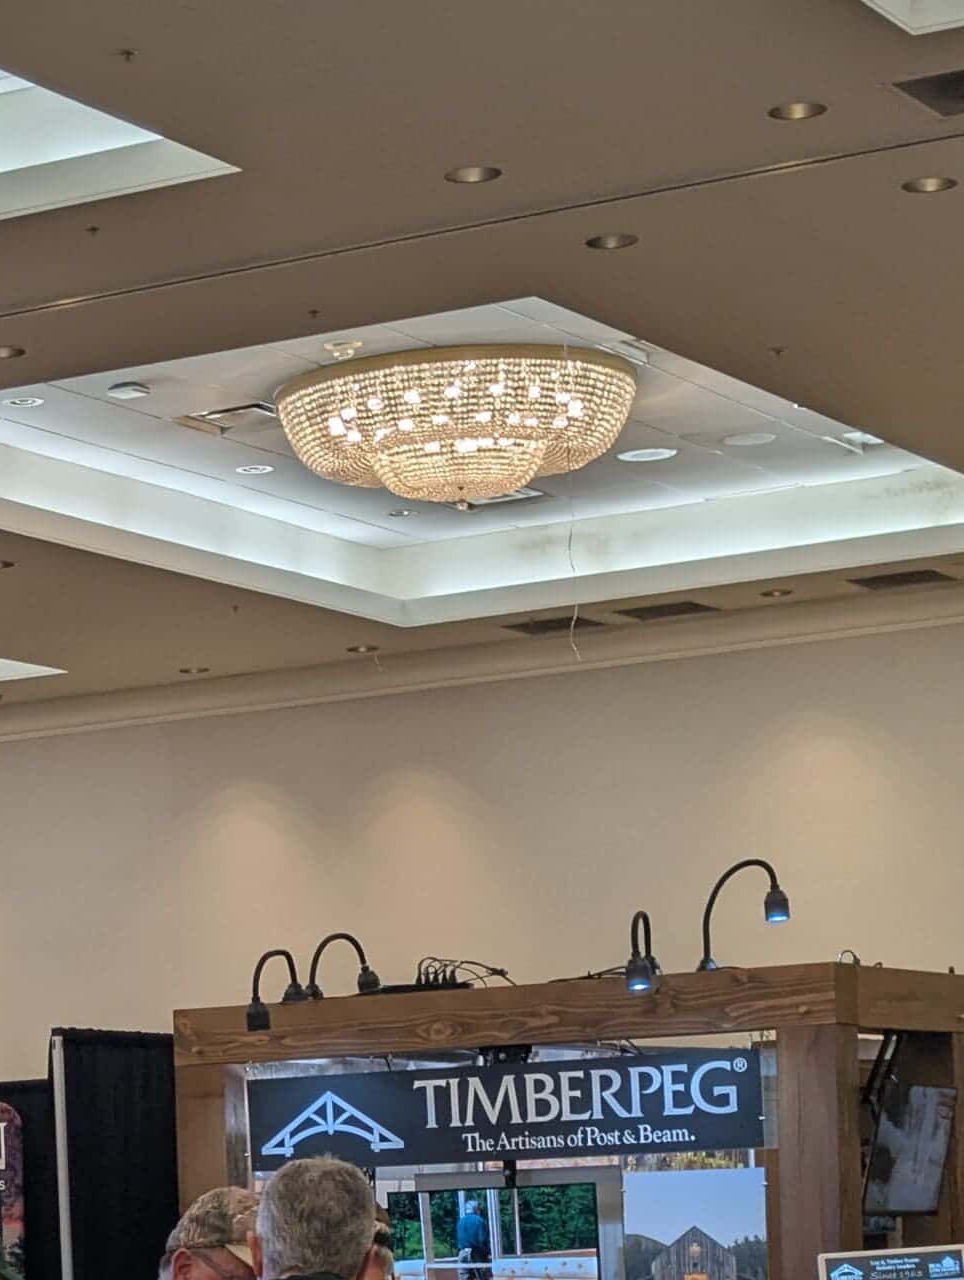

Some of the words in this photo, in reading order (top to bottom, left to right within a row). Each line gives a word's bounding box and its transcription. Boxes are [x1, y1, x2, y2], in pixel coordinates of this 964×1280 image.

[462, 1132, 496, 1152] The
[497, 1130, 565, 1151] Artisans
[567, 1127, 586, 1147] of
[586, 1127, 621, 1146] Post
[622, 1128, 637, 1145] &
[637, 1124, 696, 1145] Beam.
